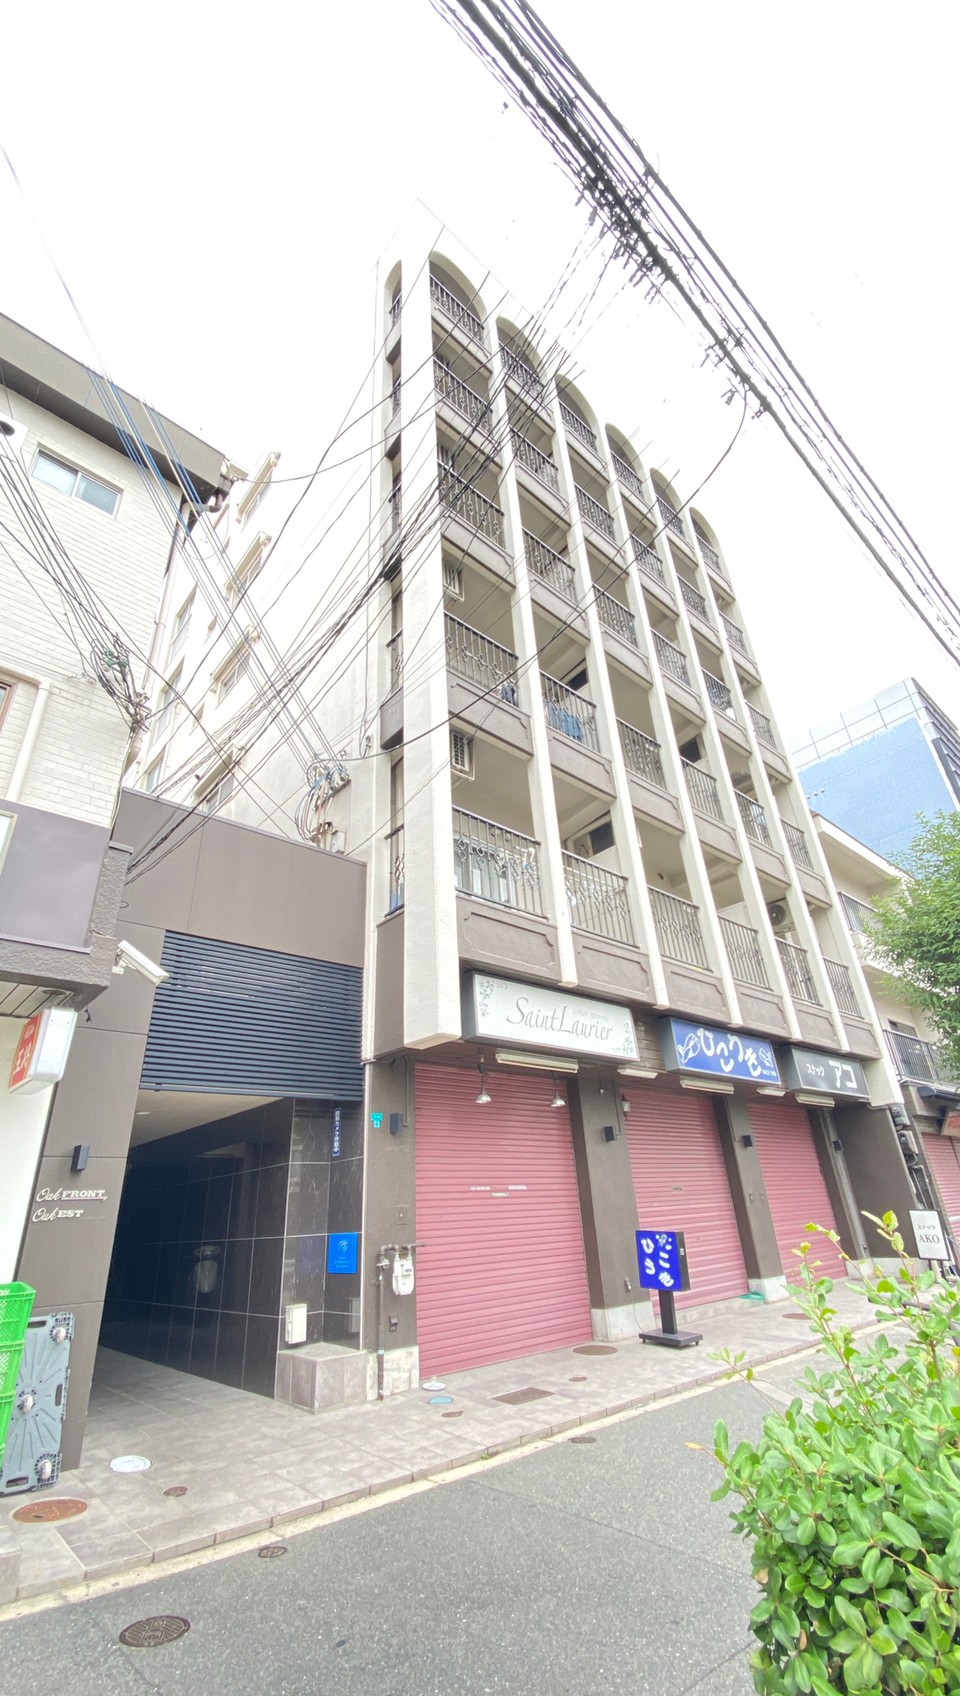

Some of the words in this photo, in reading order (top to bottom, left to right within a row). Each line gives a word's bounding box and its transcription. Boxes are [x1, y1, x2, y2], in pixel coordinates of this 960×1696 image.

[828, 1060, 857, 1089] アコ
[36, 1187, 63, 1202] Oak
[61, 1190, 106, 1198] FRONT
[32, 1207, 59, 1222] Oak
[57, 1209, 84, 1218] EST
[919, 1234, 940, 1244] AKO
